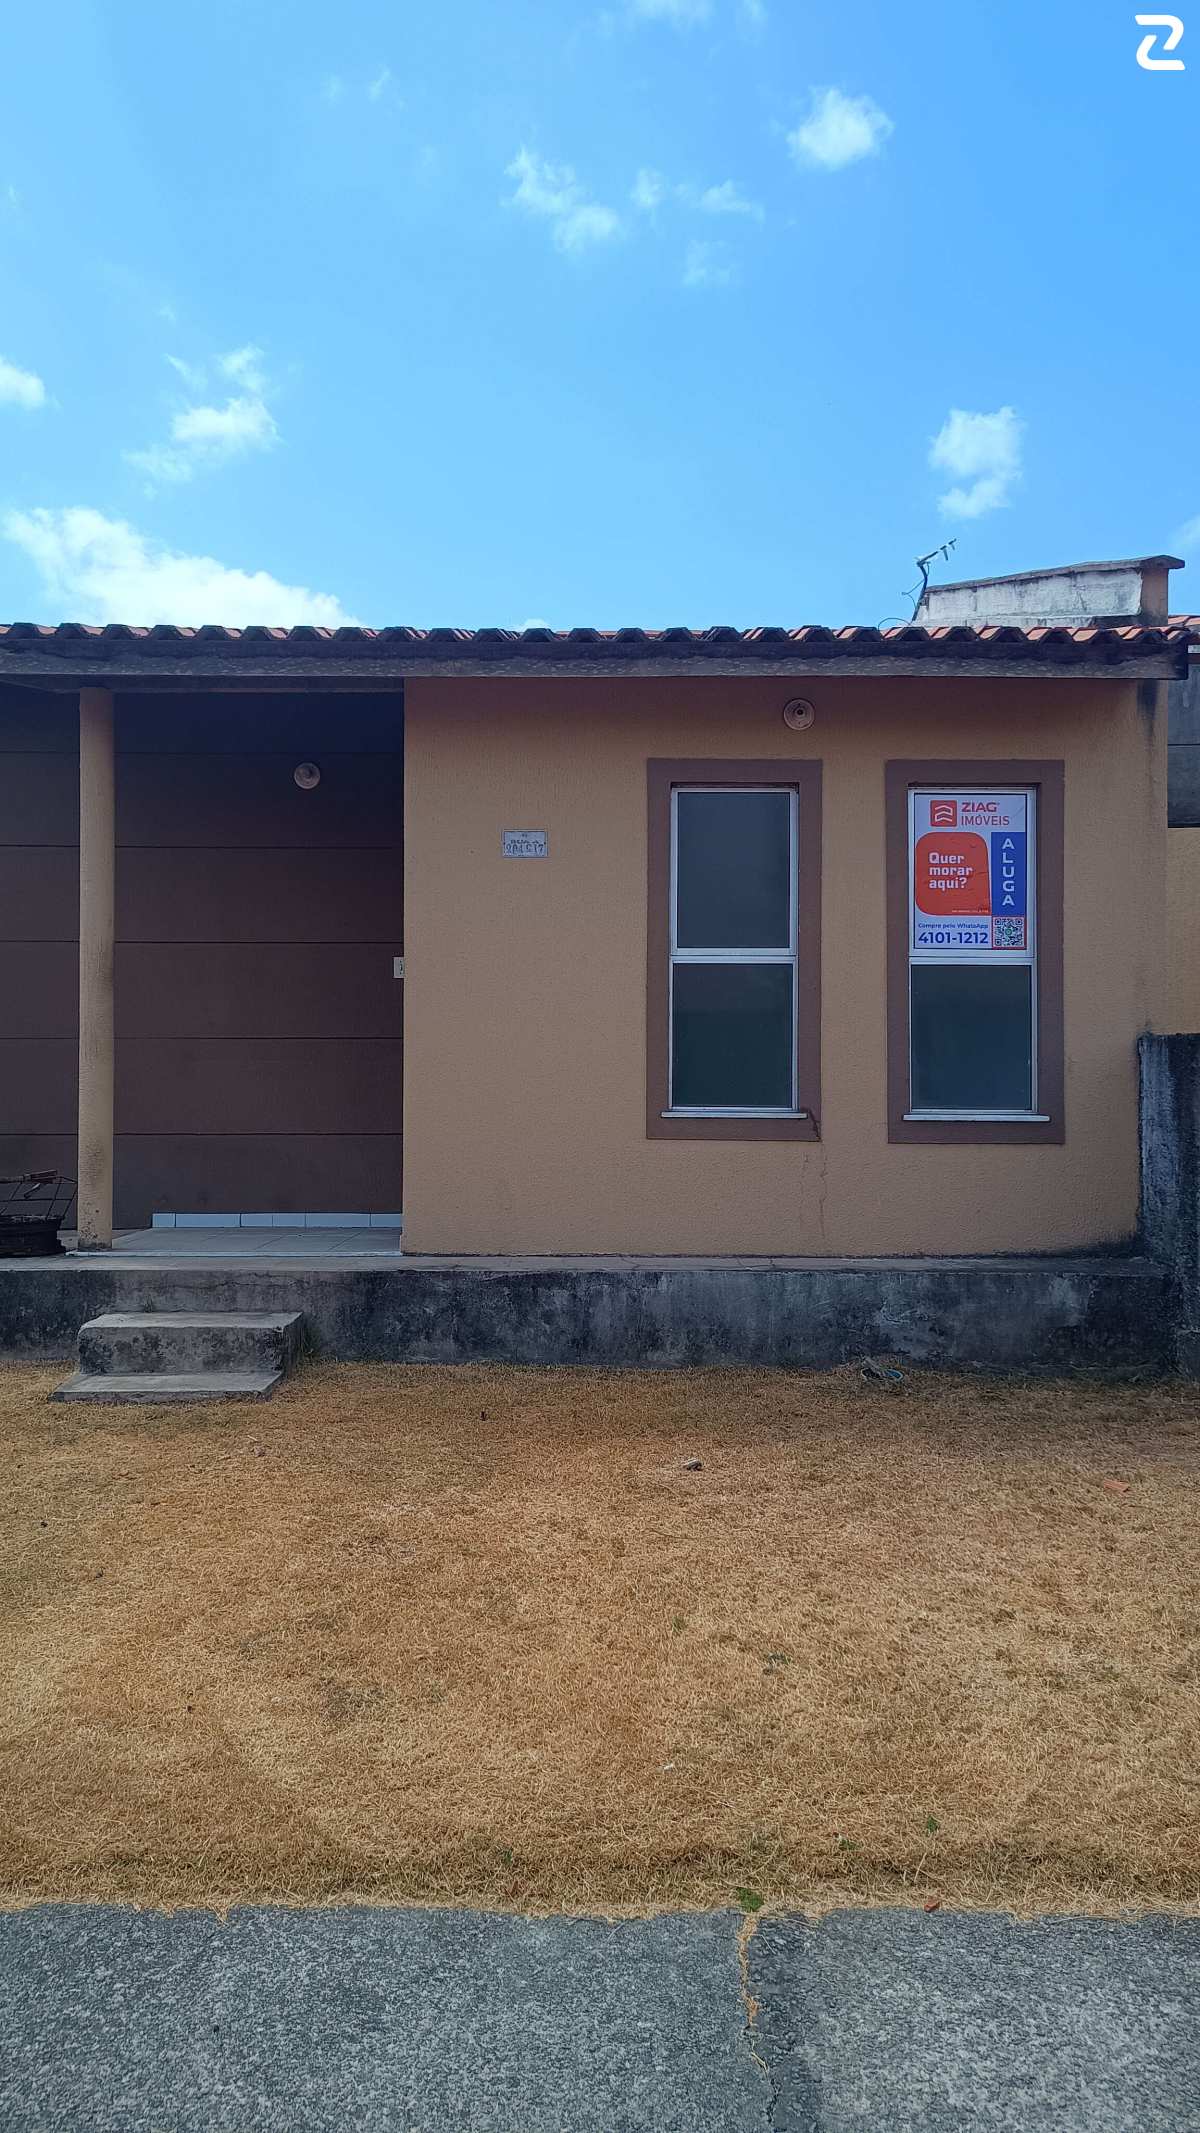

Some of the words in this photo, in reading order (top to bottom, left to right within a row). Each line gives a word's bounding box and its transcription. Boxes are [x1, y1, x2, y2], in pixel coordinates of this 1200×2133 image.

[961, 802, 998, 813] ZIAG
[961, 814, 1010, 826] IMÓVEIS
[929, 852, 965, 864] Quer
[929, 866, 973, 876] morar
[1002, 838, 1015, 906] ALUGA
[929, 877, 967, 891] aqui?
[918, 932, 989, 944] 4101-1212
